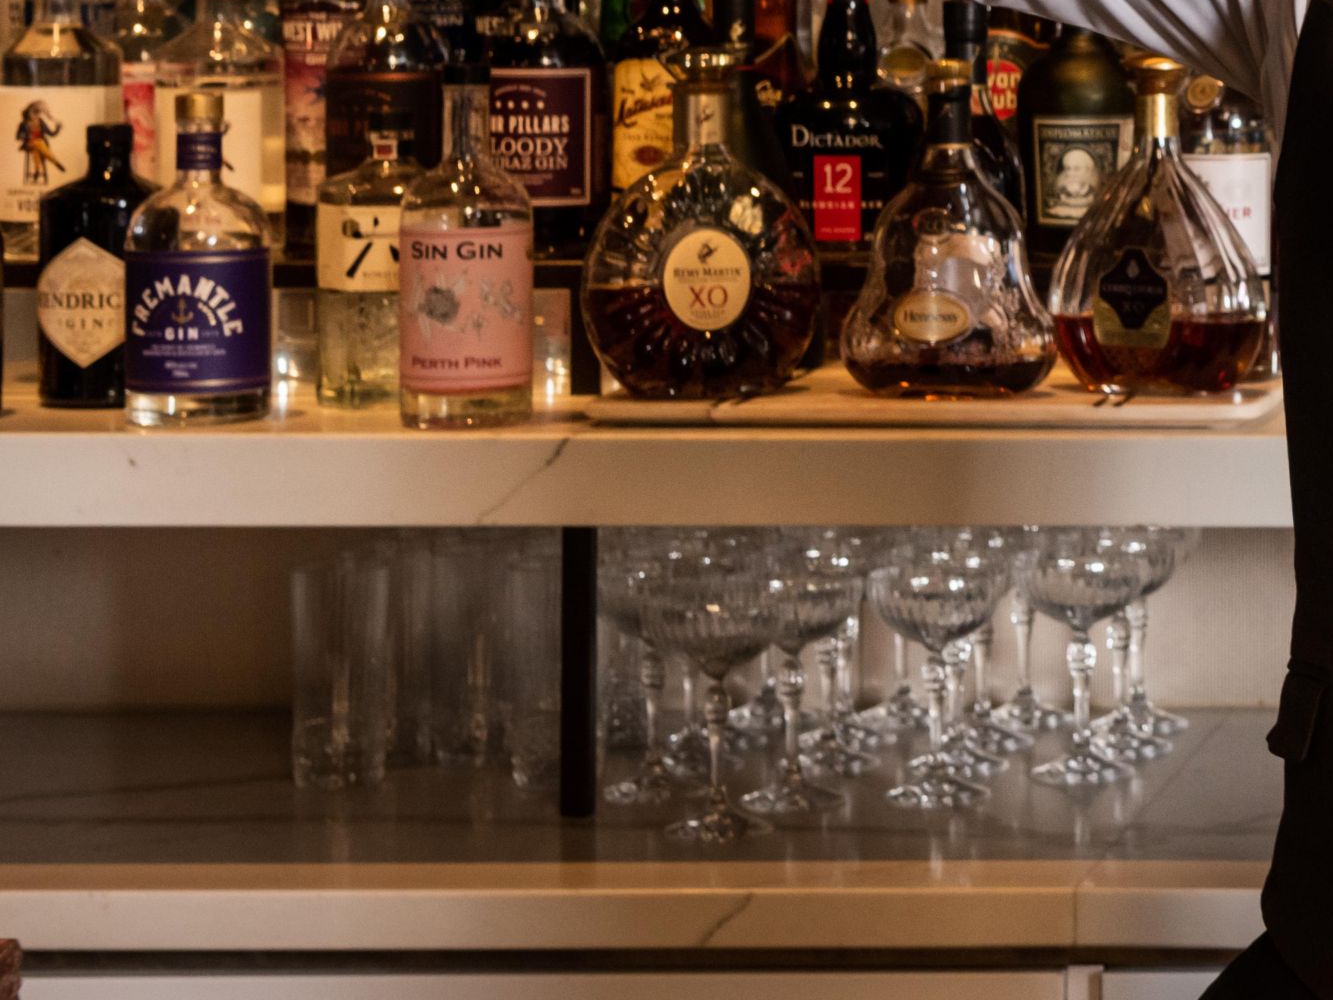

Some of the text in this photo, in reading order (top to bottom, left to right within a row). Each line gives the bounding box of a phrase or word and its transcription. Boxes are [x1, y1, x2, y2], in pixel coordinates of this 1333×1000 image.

[508, 114, 570, 134] PILLARS
[490, 136, 568, 157] LOODY
[823, 162, 854, 194] 12
[411, 241, 504, 261] SIN GIN
[132, 274, 243, 337] FREMANTLE
[689, 284, 729, 310] XO
[64, 318, 103, 330] GIN
[164, 326, 200, 341] GIN
[411, 355, 503, 370] PERTH PINK
